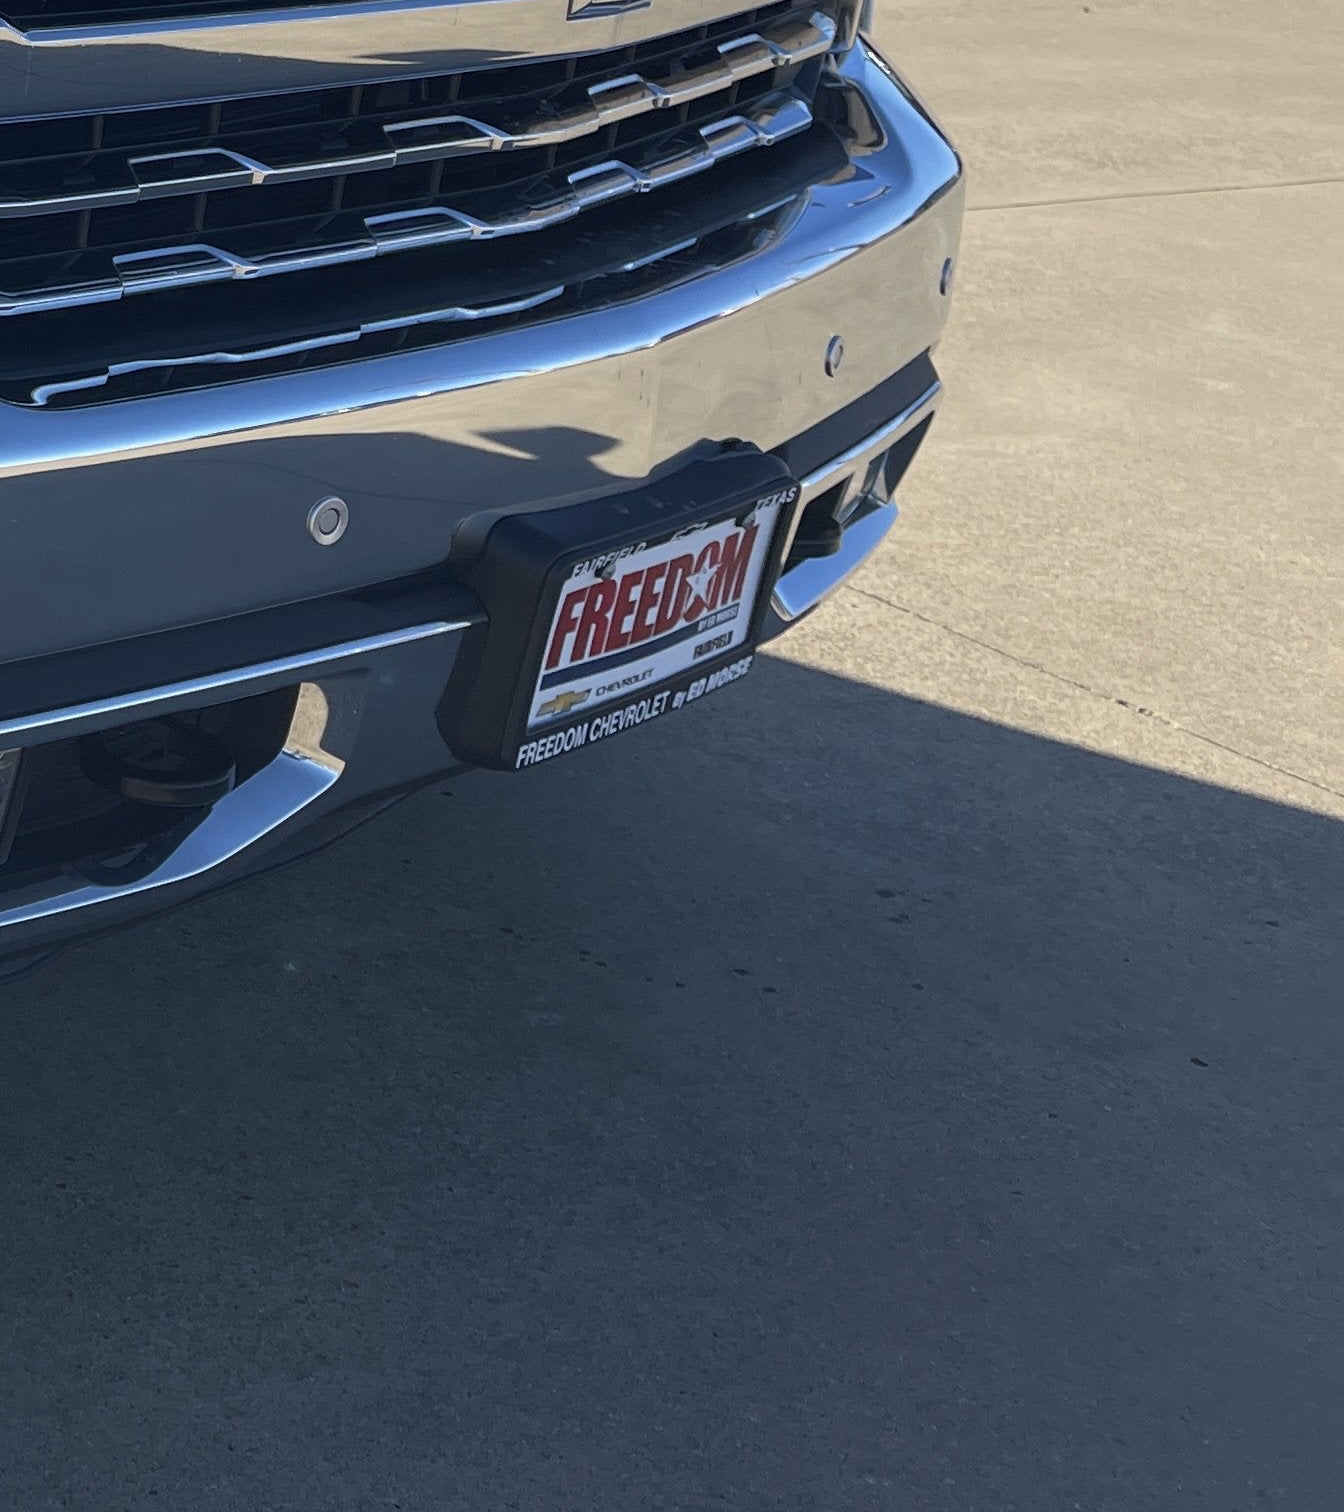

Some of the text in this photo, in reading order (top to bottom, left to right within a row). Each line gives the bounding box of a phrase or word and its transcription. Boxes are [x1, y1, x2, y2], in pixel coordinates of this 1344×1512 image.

[545, 524, 759, 670] FREEDOM
[571, 542, 647, 578] FAIRFIELD
[515, 722, 589, 770] FREEDOM
[589, 690, 671, 742] CHEVROLET
[686, 677, 709, 703] ED
[705, 655, 753, 694] MORSE
[595, 667, 655, 697] CHEVROLET
